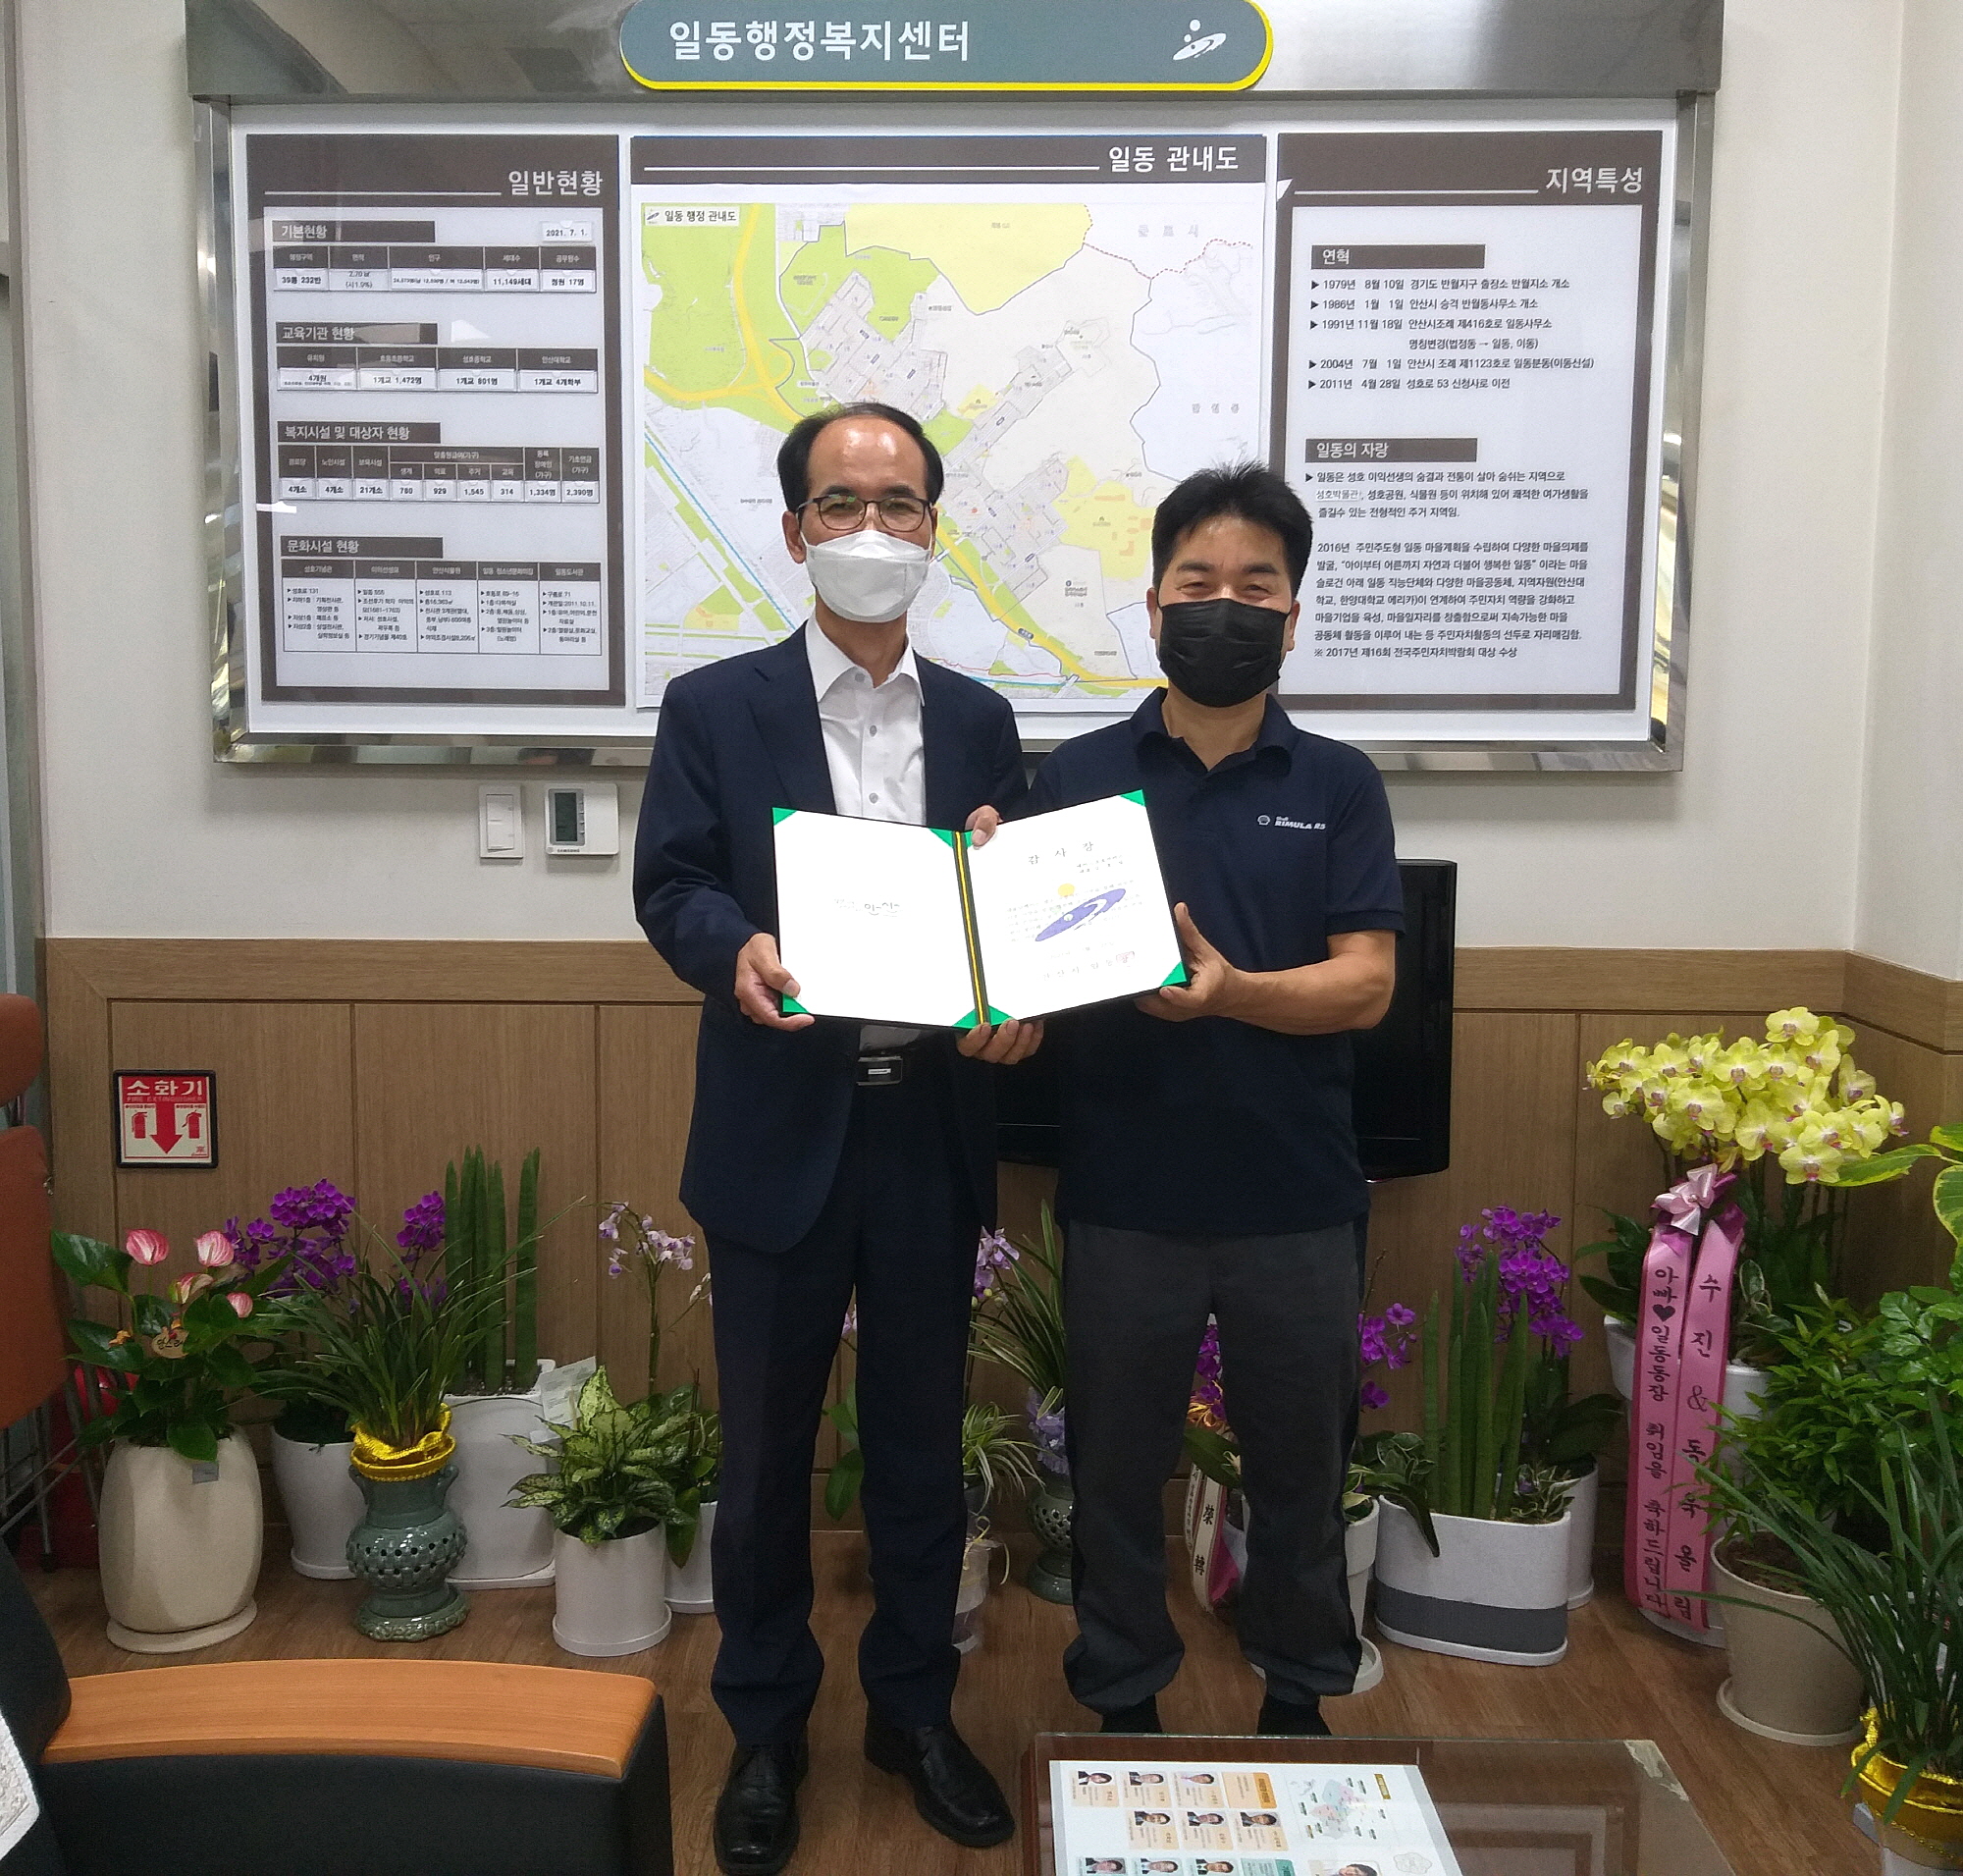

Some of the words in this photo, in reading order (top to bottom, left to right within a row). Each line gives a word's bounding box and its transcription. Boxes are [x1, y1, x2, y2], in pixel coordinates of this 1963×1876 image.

[669, 20, 970, 62] 일동행정복지센터
[1109, 146, 1155, 173] 일동
[1166, 145, 1239, 172] 관내도
[508, 170, 603, 196] 일반현황
[1545, 167, 1643, 193] 지역특성
[664, 210, 683, 222] 일동
[687, 210, 705, 222] 행정
[708, 210, 736, 222] 관내도
[282, 225, 327, 239] 기본현황
[1322, 248, 1350, 265] 연혁
[1323, 279, 1355, 290] 1979년
[1364, 279, 1380, 290] 8월
[1384, 279, 1404, 290] 10일
[1410, 279, 1437, 290] 경기도
[1441, 279, 1477, 290] 반월지구
[1481, 279, 1508, 290] 출장소
[1512, 279, 1548, 290] 반월지소
[1552, 279, 1570, 290] 개소
[1323, 299, 1354, 309] 1986년
[1365, 299, 1380, 309] 1월
[1390, 299, 1404, 309] 1일
[1409, 299, 1437, 309] 안산시
[1441, 299, 1459, 309] 승격
[1462, 299, 1516, 309] 반월동사무소
[1519, 299, 1539, 309] 개소
[1323, 319, 1354, 329] 1991년
[1358, 319, 1378, 329] 11월
[1382, 319, 1402, 329] 18일
[1408, 319, 1454, 329] 안산시조례
[1458, 319, 1503, 329] 제416호로
[1507, 319, 1552, 329] 일동사무소
[283, 326, 328, 340] 교육기관
[332, 326, 355, 340] 현황
[1492, 339, 1513, 349] 일동,
[1516, 339, 1539, 349] 이동)
[1320, 358, 1353, 369] 2004년
[1362, 358, 1377, 369] 7월
[1387, 358, 1402, 369] 1일
[1407, 358, 1434, 369] 안산시
[1438, 358, 1457, 369] 조례
[1459, 358, 1511, 369] 제1123호로
[1320, 379, 1353, 389] 2011년
[1361, 379, 1376, 389] 4월
[1380, 379, 1401, 389] 28일
[1406, 379, 1433, 389] 성호로
[1437, 379, 1449, 389] 53
[1453, 379, 1488, 389] 신청사로
[1492, 379, 1510, 389] 이전
[285, 426, 330, 440] 복지시설
[334, 426, 345, 440] 및
[349, 426, 384, 440] 대상자
[387, 426, 409, 440] 현황
[1317, 442, 1356, 458] 일동의
[1360, 442, 1389, 458] 자랑
[1317, 472, 1344, 482] 일동은
[1347, 472, 1365, 482] 성호
[1368, 472, 1413, 482] 이익선생의
[1416, 472, 1443, 482] 숨결과
[1447, 472, 1473, 482] 전통이
[1477, 472, 1495, 482] 살아
[1499, 472, 1525, 482] 숨쉬는
[1528, 472, 1565, 482] 지역으로
[287, 540, 333, 553] 문화시설
[337, 540, 359, 553] 현황
[1326, 648, 1358, 658] 2017년
[1361, 648, 1391, 658] 제16회
[1478, 647, 1496, 657] 대상
[1499, 647, 1517, 657] 수상
[1029, 841, 1093, 864] 감사장
[127, 1080, 202, 1096] 소화기
[1687, 1384, 1708, 1412] &
